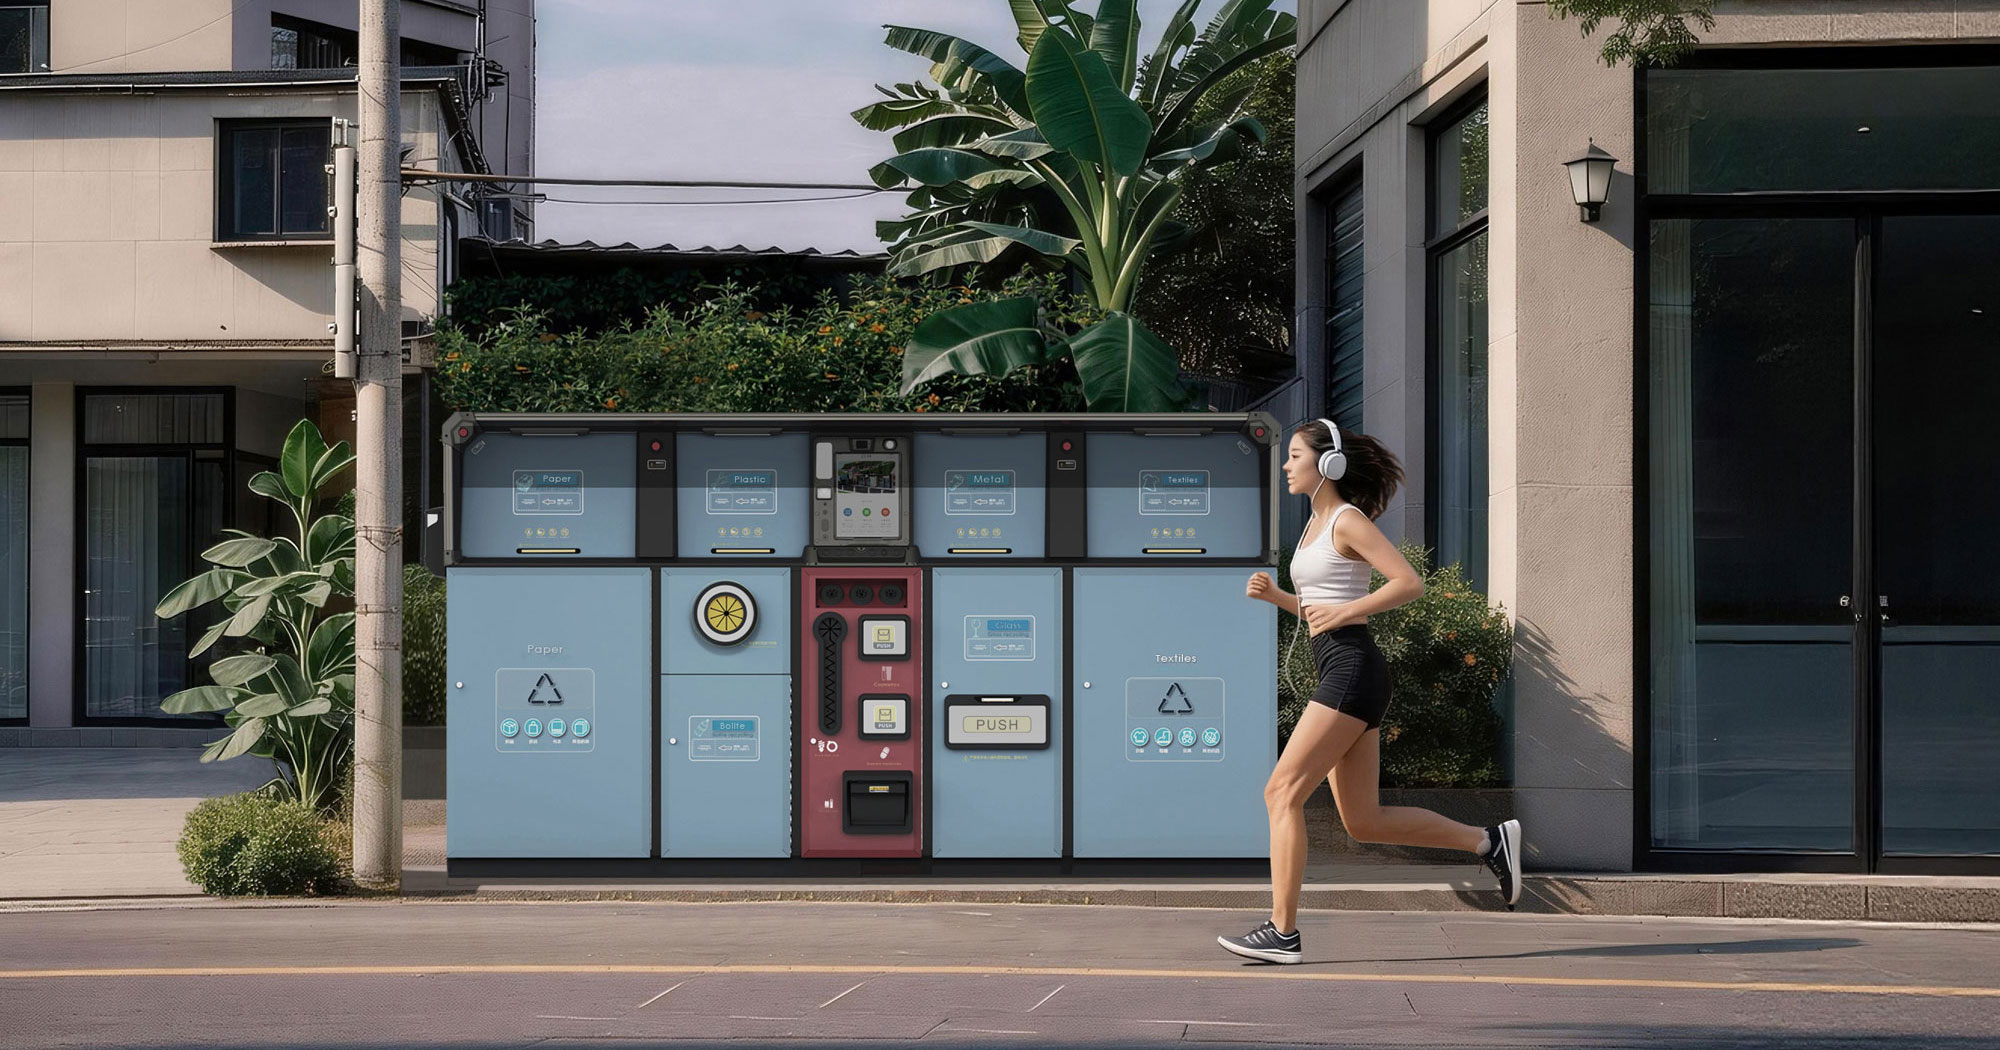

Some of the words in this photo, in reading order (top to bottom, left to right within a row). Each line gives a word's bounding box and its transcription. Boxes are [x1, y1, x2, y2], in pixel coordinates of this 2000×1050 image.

[542, 474, 572, 484] Paper
[734, 475, 767, 484] Plastic
[973, 474, 1005, 484] Metal
[527, 644, 564, 656] Paper
[1155, 654, 1198, 663] Textiles
[976, 719, 1018, 731] PUSH
